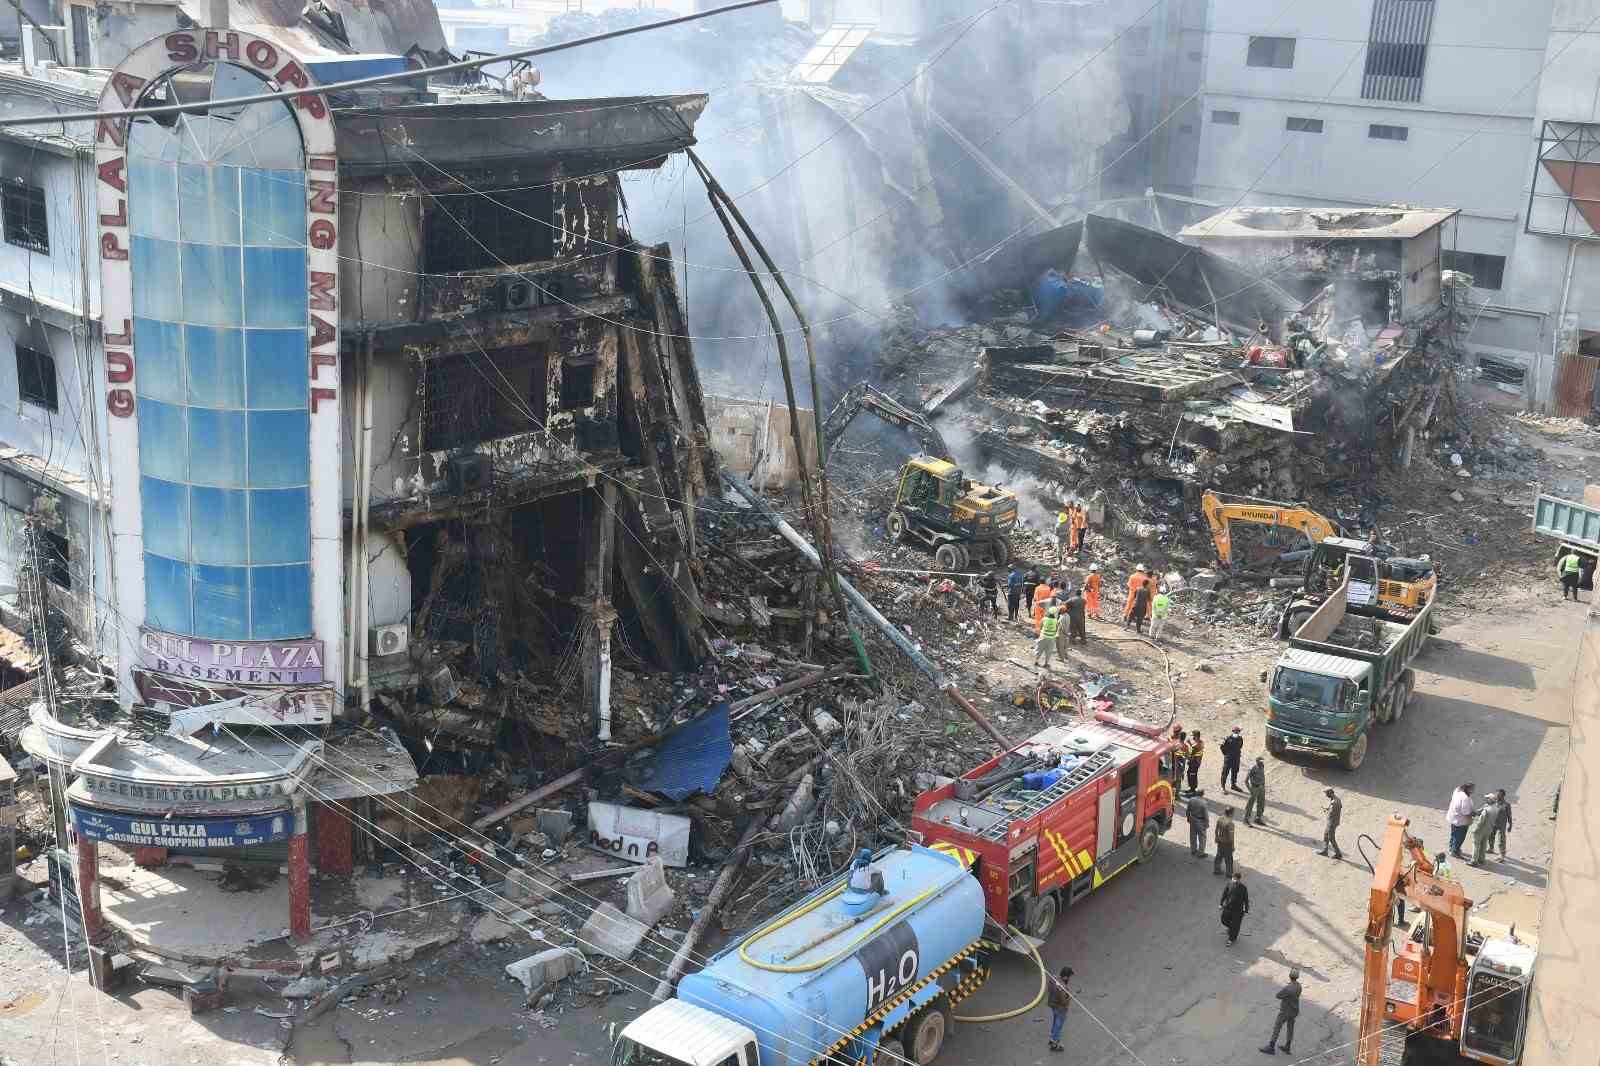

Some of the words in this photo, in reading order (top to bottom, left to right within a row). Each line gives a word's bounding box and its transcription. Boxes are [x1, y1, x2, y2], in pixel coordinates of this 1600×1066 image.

[97, 71, 147, 260] PLAZA
[310, 271, 337, 414] MALL
[105, 319, 135, 417] GUL
[143, 633, 200, 663] GUL
[211, 643, 322, 668] PLAZA
[157, 659, 304, 682] BASEMENT
[131, 821, 158, 836] GUL
[160, 823, 207, 838] PLAZA
[154, 836, 206, 848] SHOPPING
[207, 836, 235, 847] MALL
[867, 949, 918, 1010] H2O
